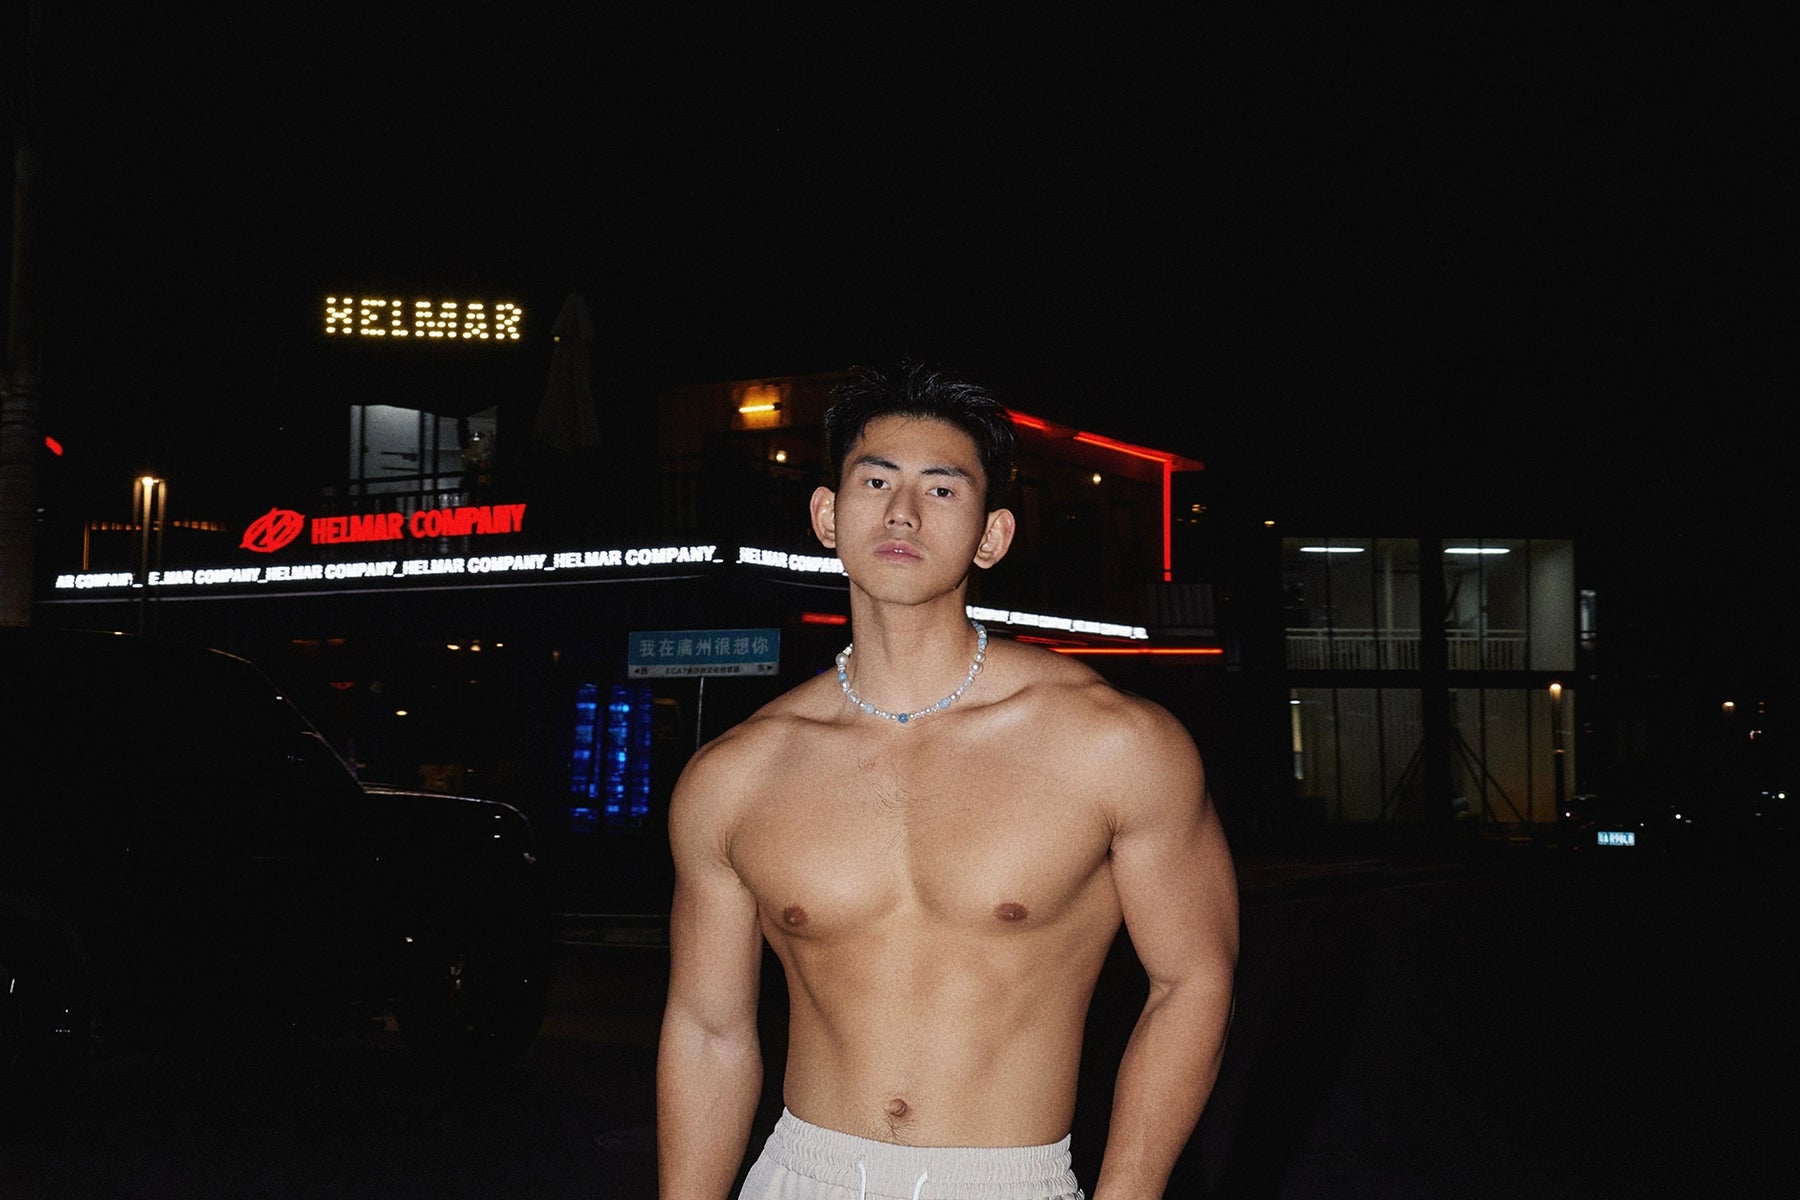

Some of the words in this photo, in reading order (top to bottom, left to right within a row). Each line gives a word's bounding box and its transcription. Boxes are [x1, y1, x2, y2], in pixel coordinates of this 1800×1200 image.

[326, 297, 522, 339] HELMAR
[312, 513, 404, 544] HELMAR
[410, 504, 526, 538] COMPANY
[639, 637, 769, 658] 我在廣州很想你
